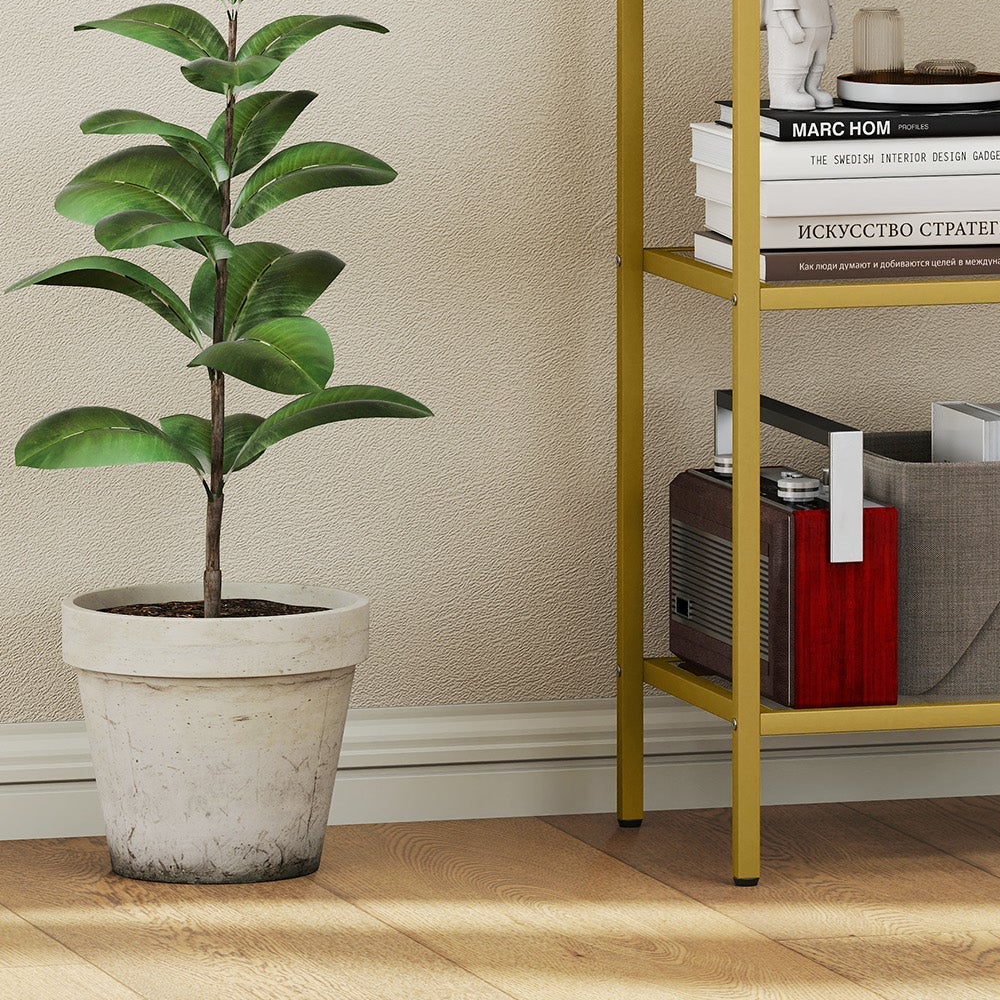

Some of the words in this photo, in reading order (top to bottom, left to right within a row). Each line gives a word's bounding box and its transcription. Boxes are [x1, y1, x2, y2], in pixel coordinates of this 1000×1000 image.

[792, 122, 845, 137] MARC
[849, 120, 891, 136] HOM
[811, 155, 828, 165] THE
[834, 154, 874, 165] SWEDISH
[881, 152, 927, 164] INTERIOR
[932, 151, 967, 162] DESIGN
[798, 223, 913, 240] ИСКУССТВО
[799, 262, 814, 271] Как
[815, 262, 837, 271] люди
[839, 261, 871, 271] думают
[880, 259, 930, 269] добиваются
[931, 258, 956, 267] целей
